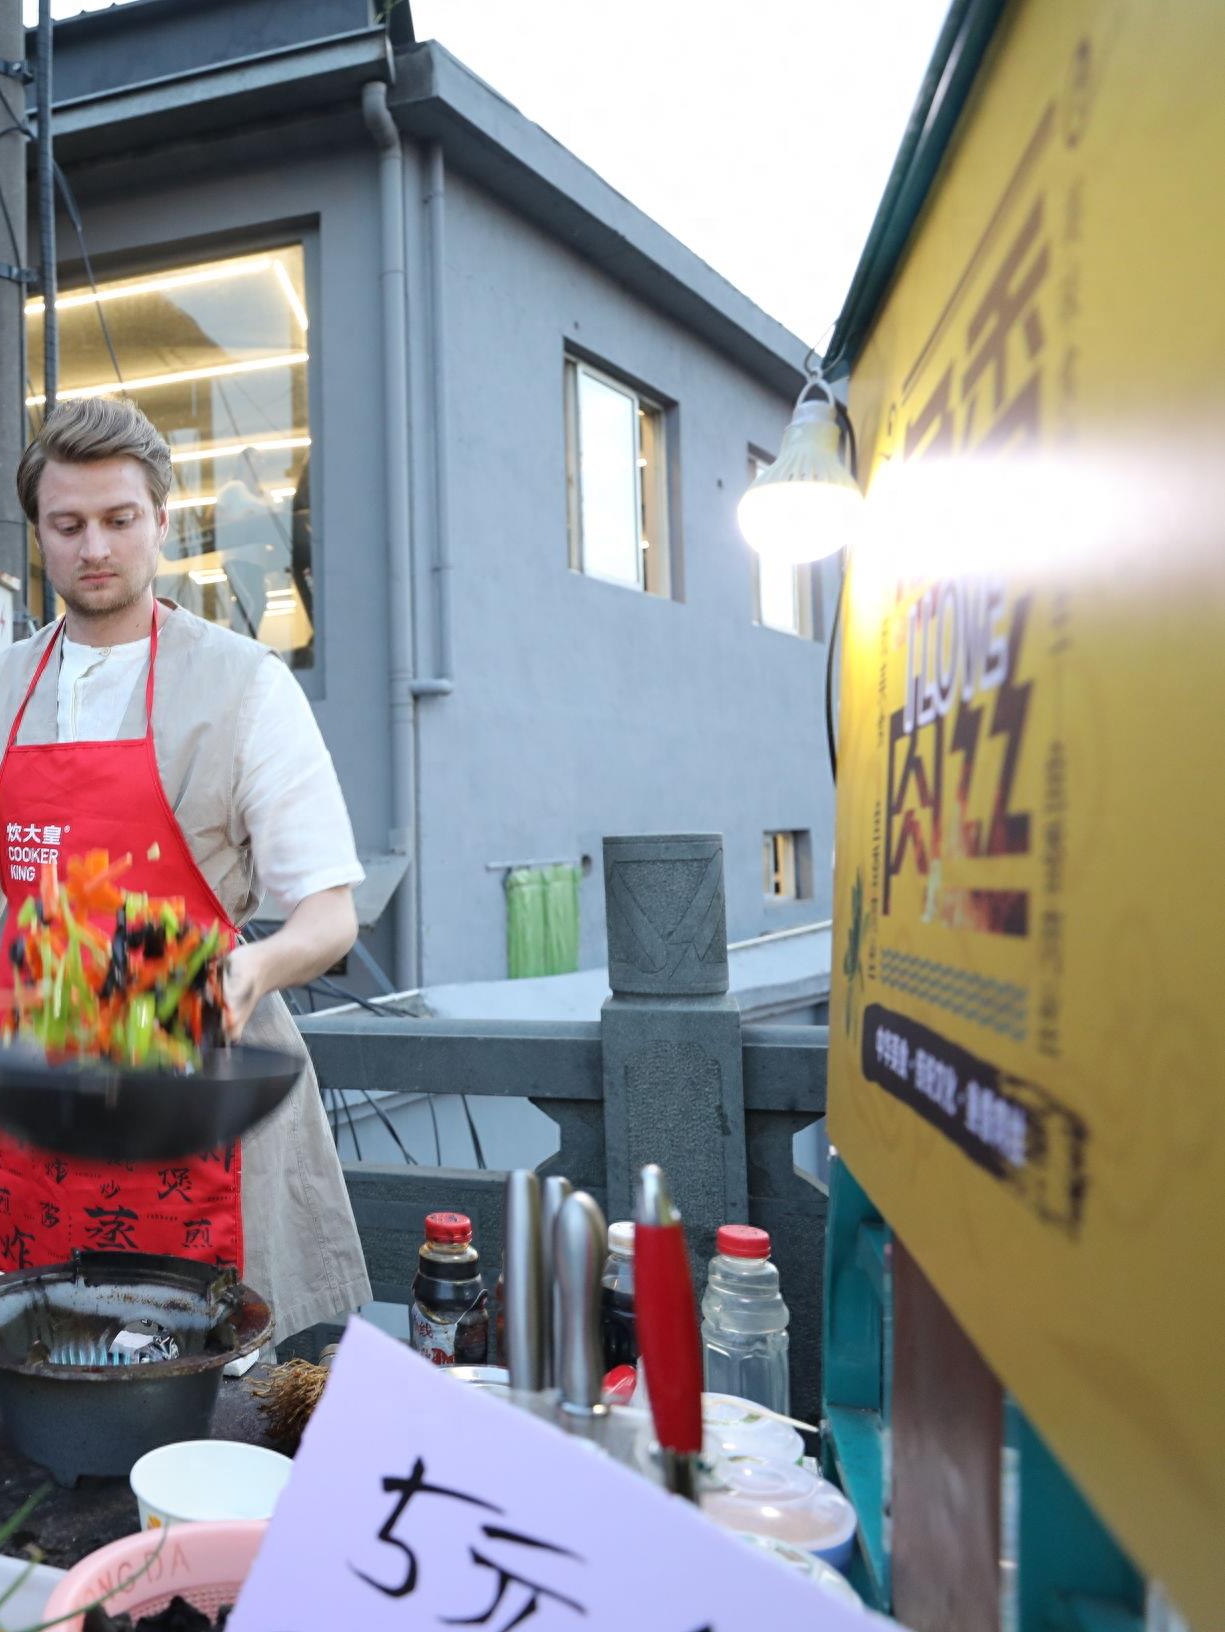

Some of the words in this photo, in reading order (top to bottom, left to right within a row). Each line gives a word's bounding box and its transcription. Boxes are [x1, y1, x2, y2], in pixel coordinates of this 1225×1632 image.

[8, 846, 59, 864] COOKER
[10, 864, 36, 881] KING
[100, 1180, 121, 1199] 炒
[83, 1204, 139, 1252] 蒸
[182, 1218, 214, 1248] 煎
[0, 1223, 36, 1269] 炸
